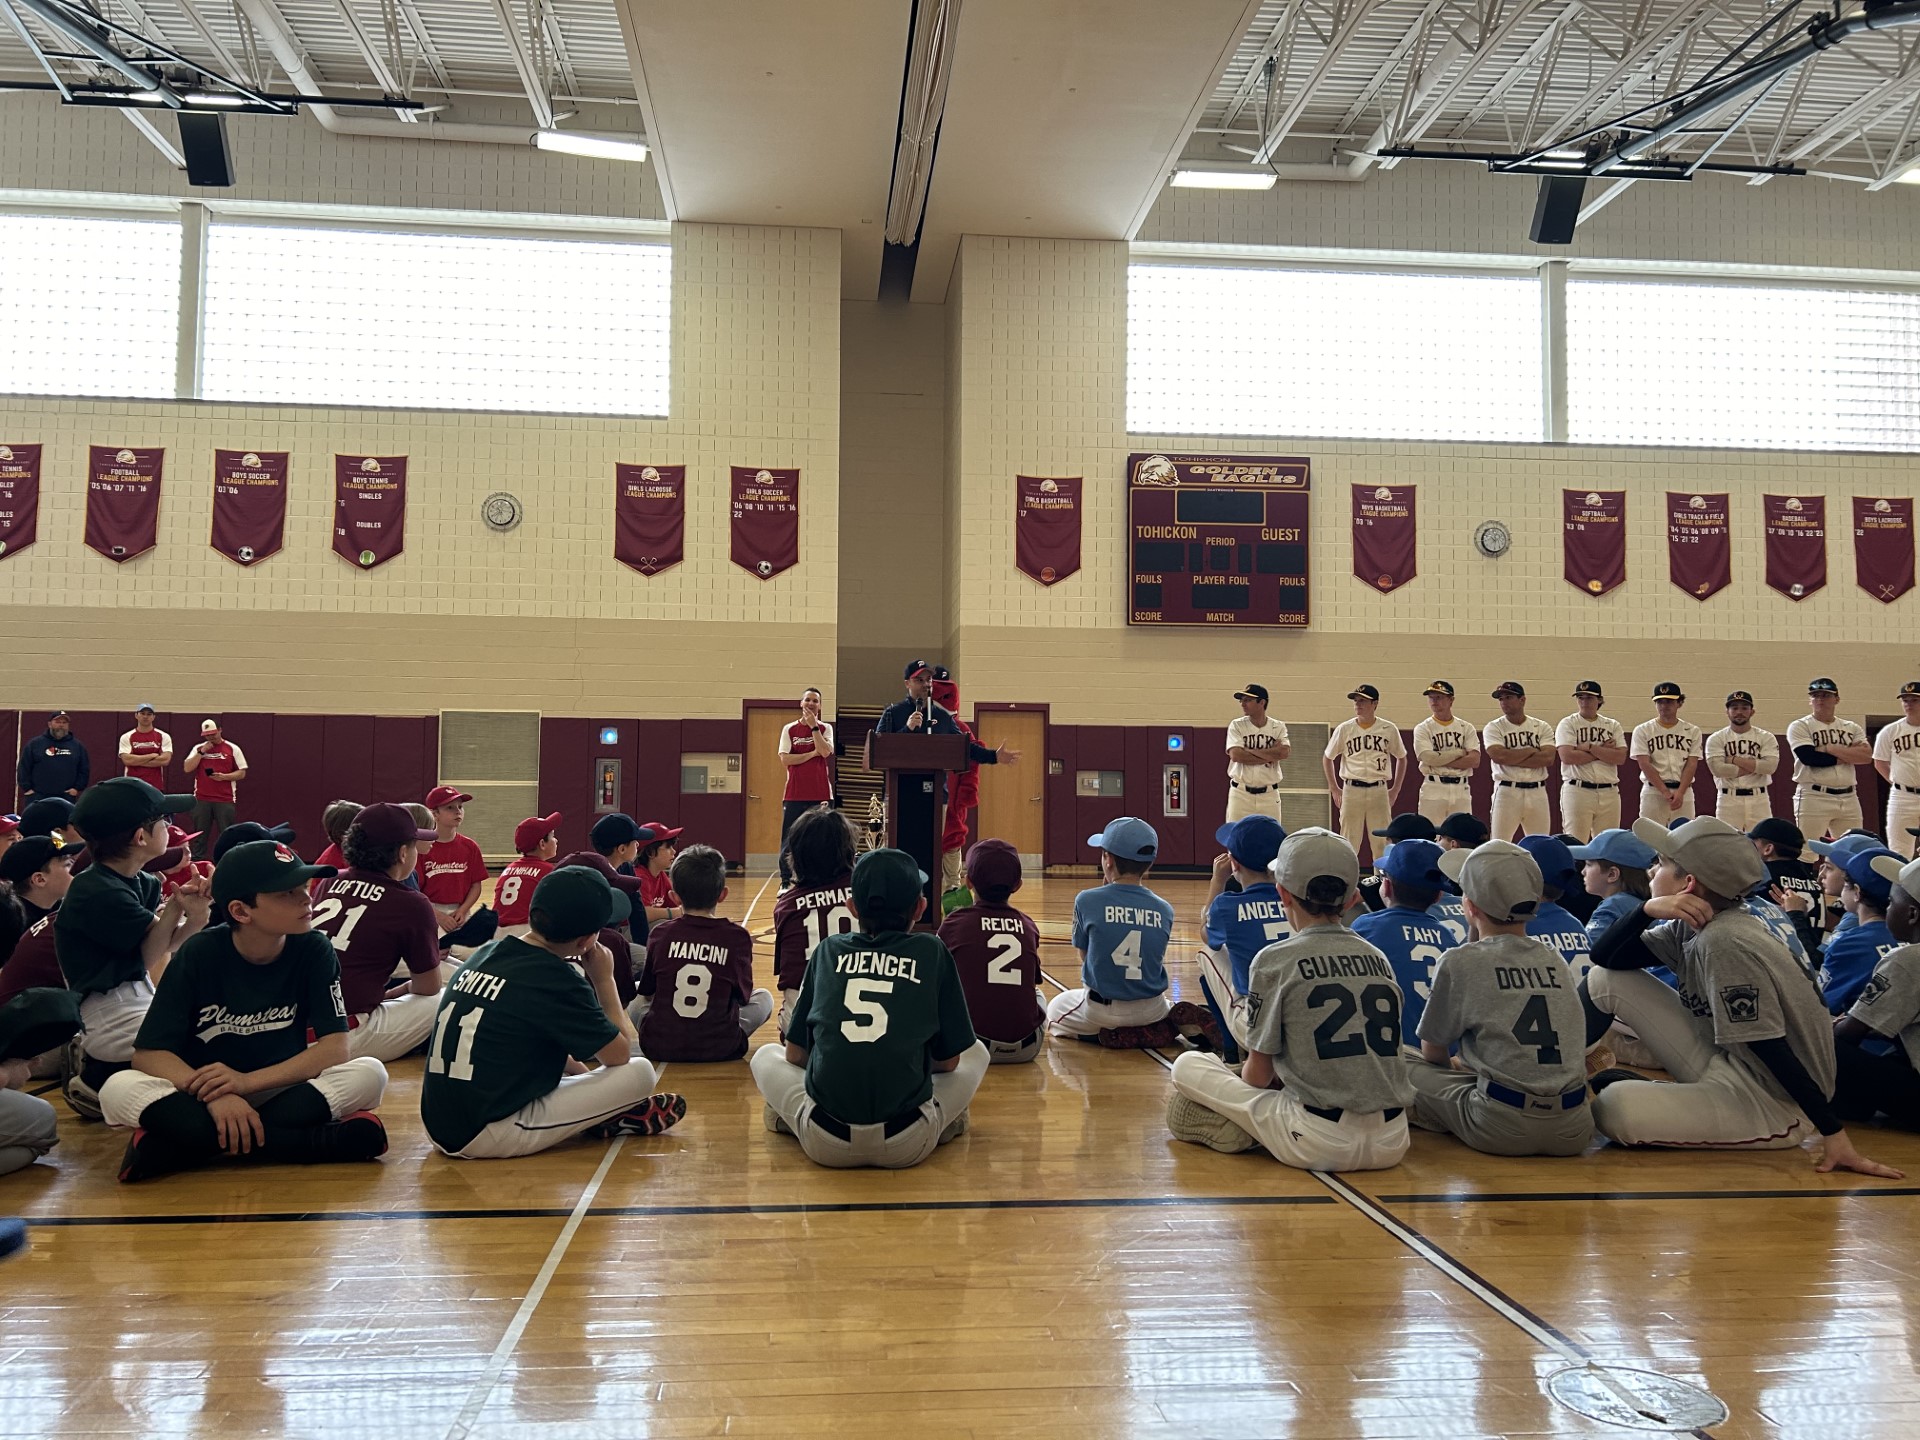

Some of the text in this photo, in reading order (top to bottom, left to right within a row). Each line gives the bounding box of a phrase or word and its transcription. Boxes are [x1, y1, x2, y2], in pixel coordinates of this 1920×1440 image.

[96, 473, 120, 481] LEAGUE
[111, 468, 140, 476] FOOTBALL
[1190, 466, 1278, 475] GOLDEN
[1211, 474, 1297, 483] EAGLES
[222, 477, 245, 485] LEAGUE
[343, 481, 365, 489] LEAGUE
[358, 492, 382, 500] SINGLES
[624, 490, 645, 498] LEAGUE
[738, 493, 759, 501] LEAGUE
[1136, 525, 1300, 541] TOHICKON GUEST
[1206, 537, 1235, 546] PERIOD
[1136, 575, 1162, 584] FOULS
[1193, 576, 1250, 585] PLAYER FOUL
[1279, 577, 1306, 586] FOULS
[1135, 612, 1162, 621] SCORE
[1206, 613, 1234, 622] MATCH
[1279, 614, 1306, 623] SCORE
[1432, 731, 1465, 752] BUCK
[1577, 727, 1614, 744] UCKS
[1647, 734, 1693, 755] BUCKS
[1812, 729, 1855, 748] BUCKS
[1346, 735, 1390, 757] BUCKS
[327, 879, 386, 902] LOFTUS
[500, 876, 523, 906] 8
[310, 898, 368, 952] 21
[981, 917, 1025, 935] REICH
[1105, 905, 1162, 929] BREWER
[803, 906, 861, 961] 10
[1402, 925, 1442, 945] FAHY
[667, 941, 728, 966] MANCINI
[987, 933, 1022, 986] 2
[1111, 930, 1143, 981] 4
[835, 951, 921, 985] YUENGEL
[452, 969, 507, 1001] SMITH
[1494, 966, 1561, 990] DOYLE
[672, 963, 713, 1019] 8
[840, 977, 894, 1043] 5
[220, 1026, 267, 1034] BASEBALL
[1306, 982, 1400, 1060] 28
[1511, 994, 1563, 1065] 4
[428, 1001, 484, 1081] 11
